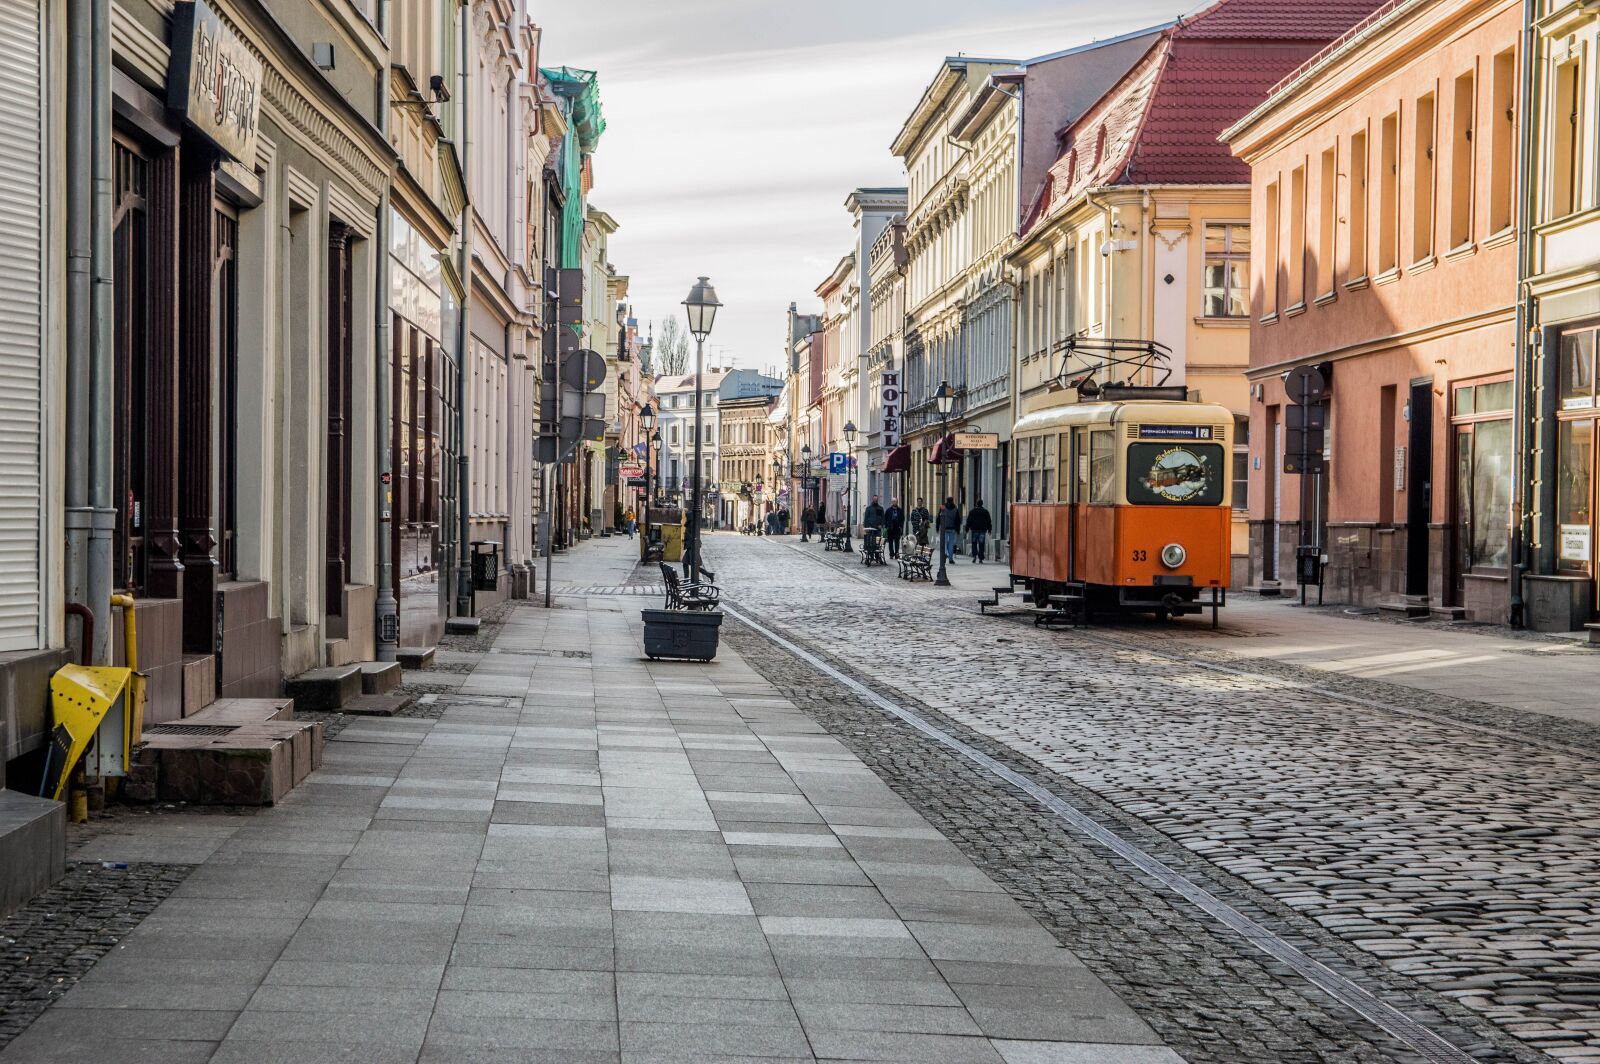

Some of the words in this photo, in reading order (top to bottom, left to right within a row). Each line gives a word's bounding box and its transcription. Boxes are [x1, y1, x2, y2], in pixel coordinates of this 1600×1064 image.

[882, 373, 899, 447] HOTEL
[833, 454, 844, 468] P
[1132, 550, 1147, 562] 33
